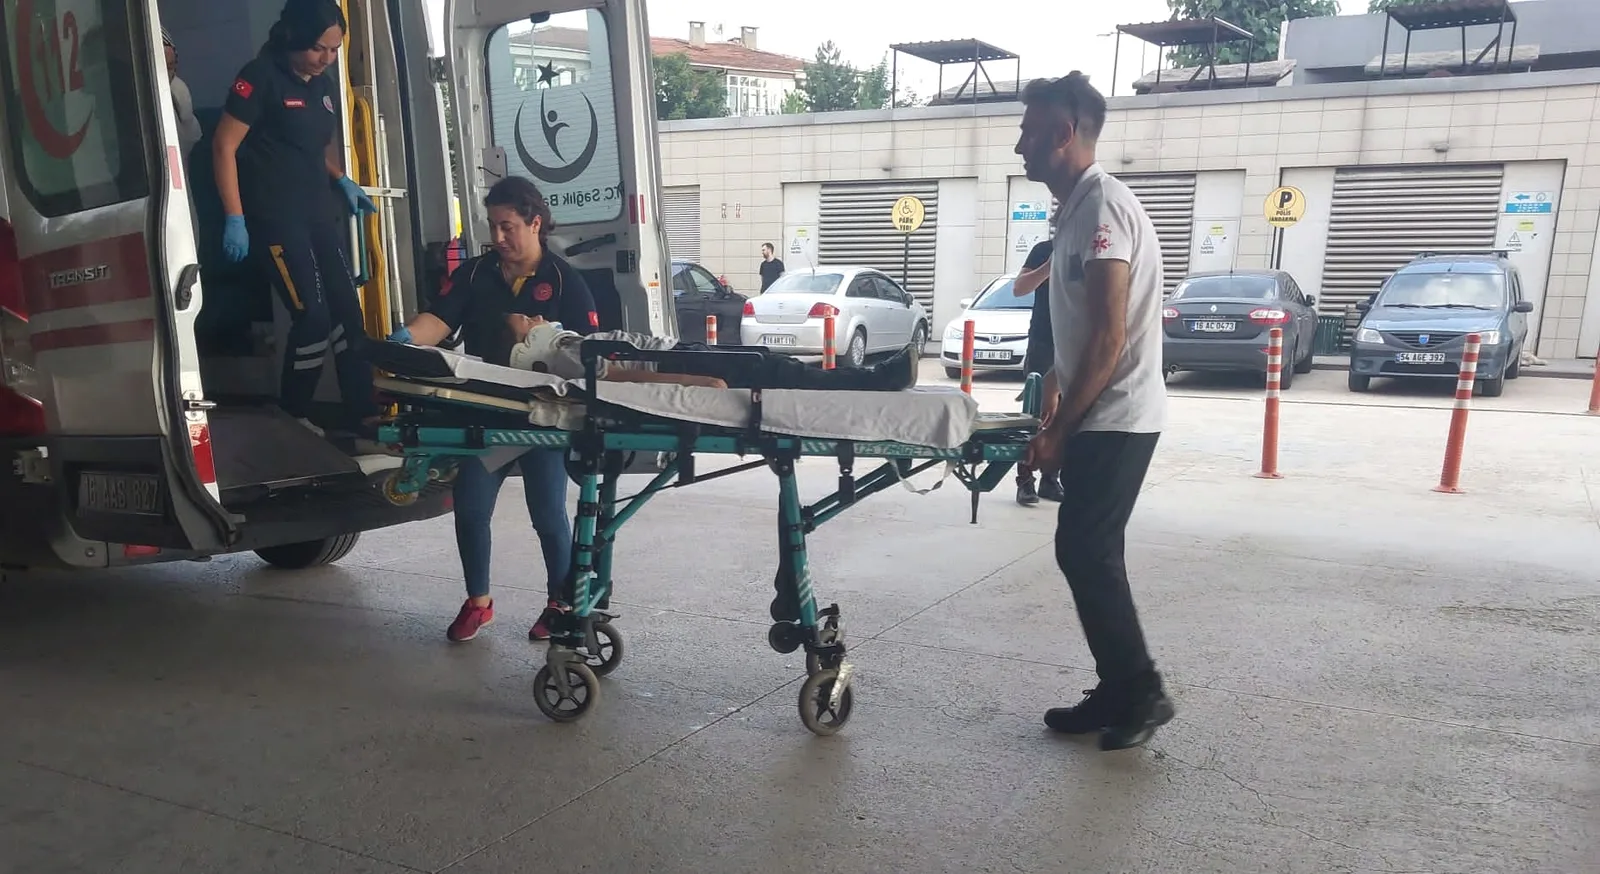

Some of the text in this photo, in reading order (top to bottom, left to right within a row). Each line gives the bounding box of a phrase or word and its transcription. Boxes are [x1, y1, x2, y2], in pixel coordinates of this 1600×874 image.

[1279, 191, 1293, 208] P
[50, 264, 108, 288] TRANSIT
[1205, 322, 1214, 330] AC
[1400, 353, 1444, 361] 54 AGE 392
